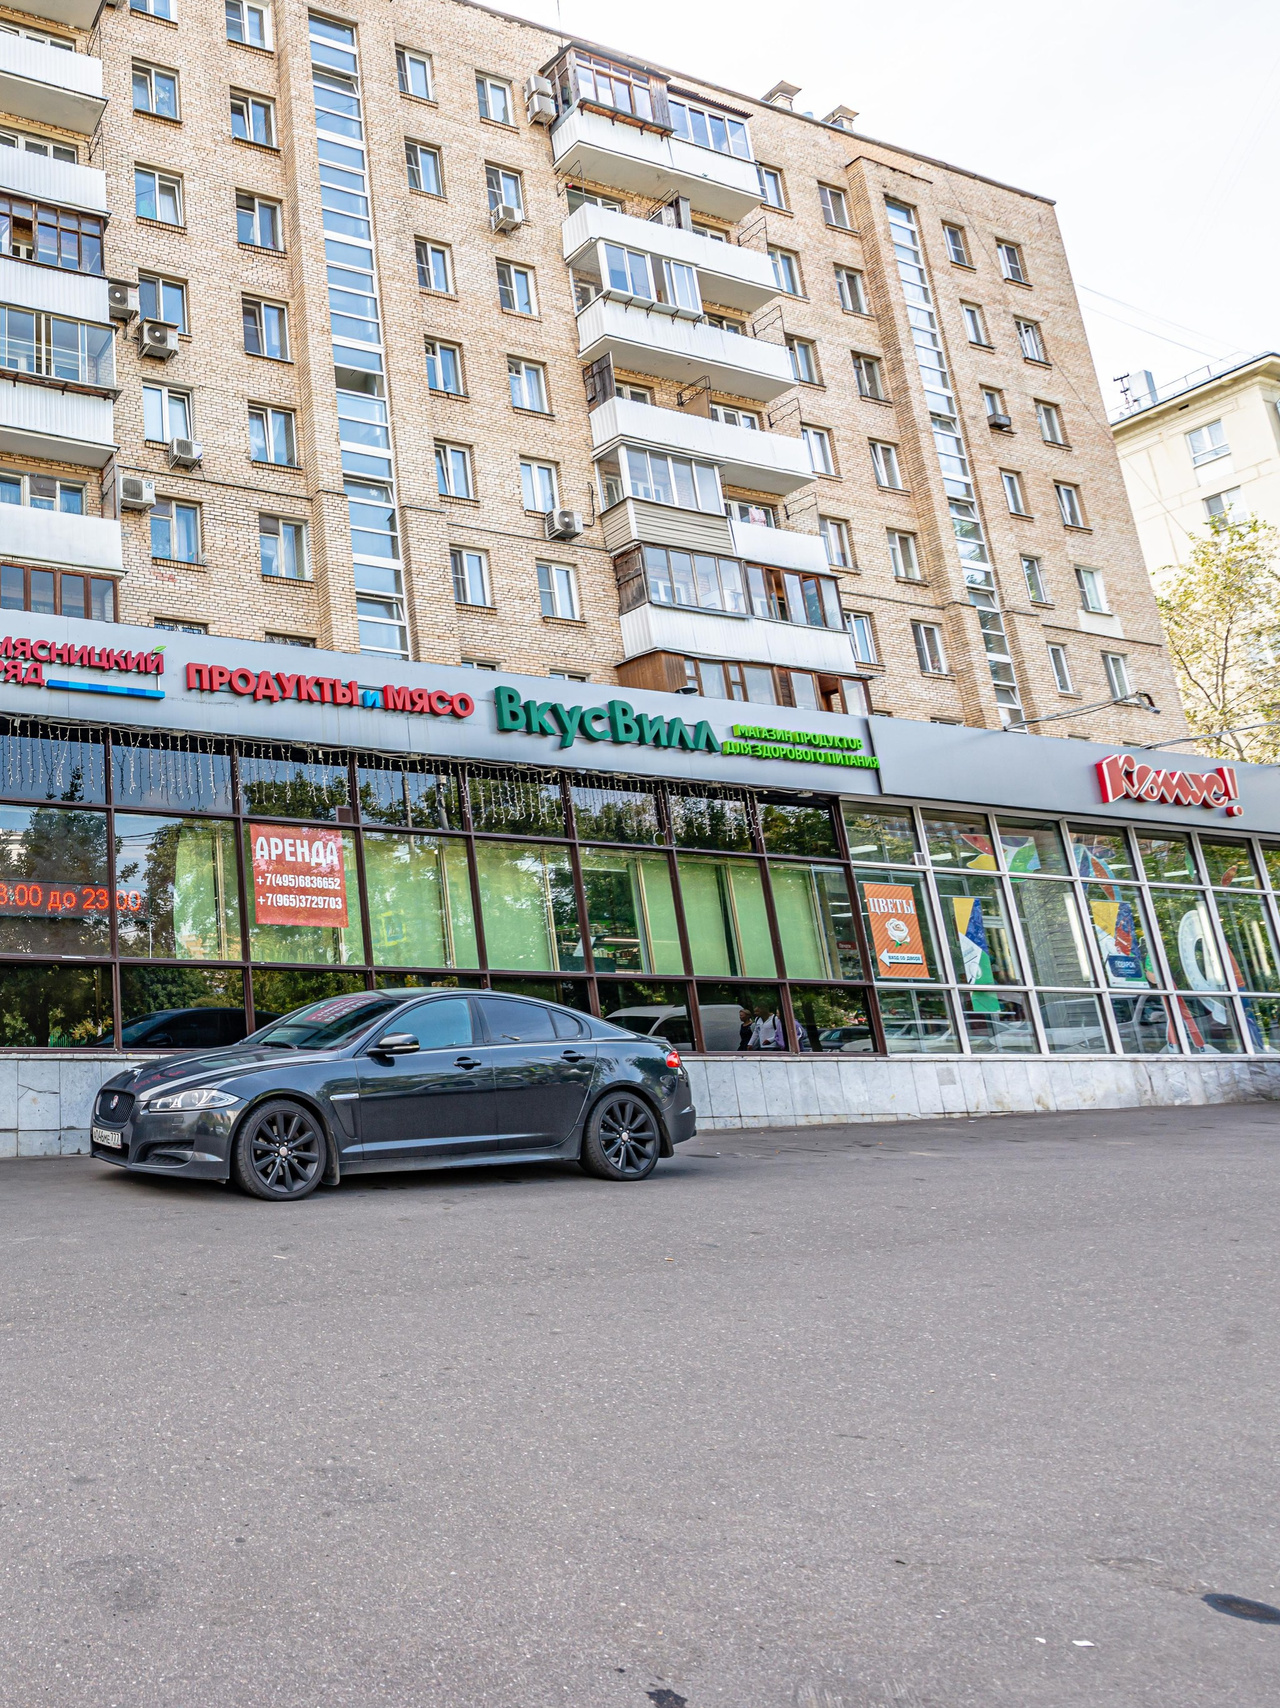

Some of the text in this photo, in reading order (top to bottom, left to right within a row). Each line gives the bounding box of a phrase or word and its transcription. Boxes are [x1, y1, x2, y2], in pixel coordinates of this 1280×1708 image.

[186, 662, 359, 706] ПРОДУКТЫ
[383, 684, 475, 719] МЯСО
[732, 724, 864, 751] МАГАЗИН ПРОДУКТОВ
[722, 740, 880, 769] ДЛЯ ЗДОРОВОГО ПИТАНИЯ
[255, 836, 339, 867] АРЕНДА
[47, 890, 77, 911] до
[868, 897, 915, 915] ЦВЕТЫ
